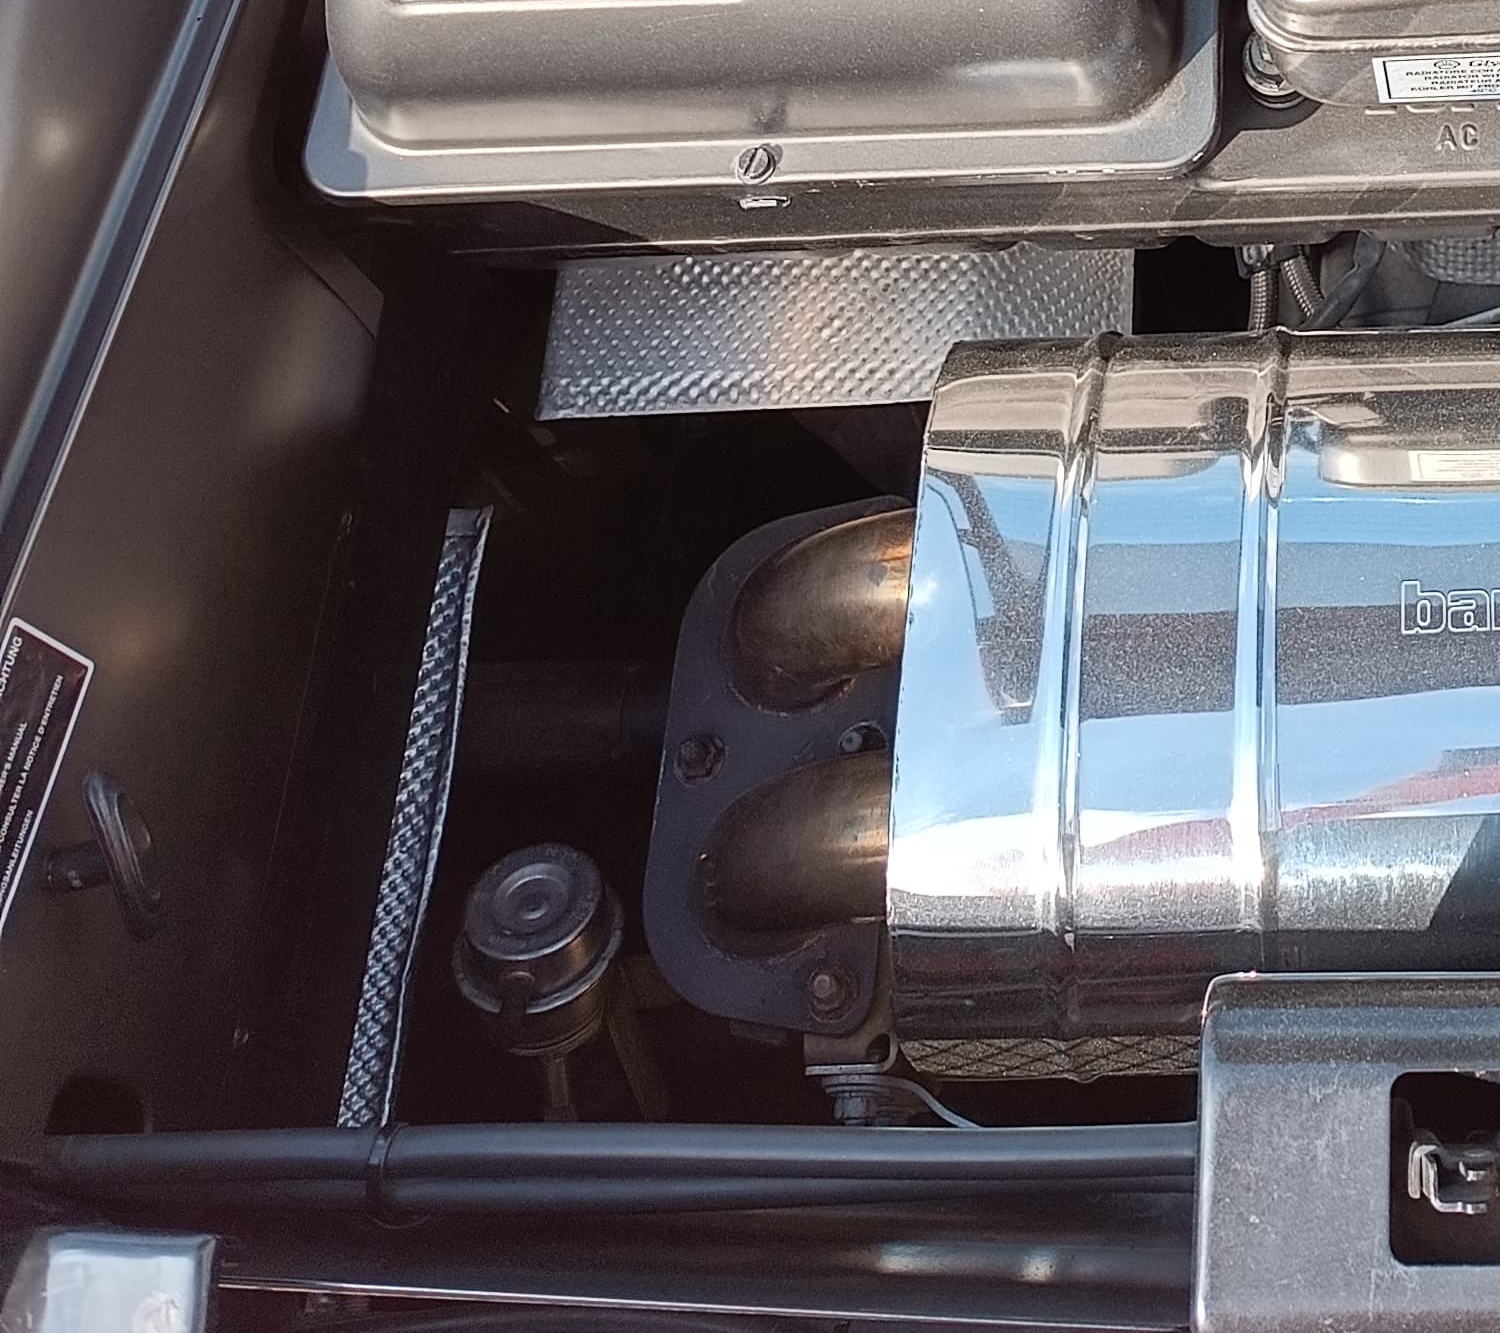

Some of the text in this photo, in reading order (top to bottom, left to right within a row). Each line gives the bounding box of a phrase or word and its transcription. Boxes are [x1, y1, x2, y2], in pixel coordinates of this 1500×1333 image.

[1435, 123, 1479, 151] AC
[0, 636, 22, 699] CHTUNG
[7, 721, 28, 762] MANUAL
[18, 771, 28, 786] LA
[23, 735, 42, 771] NOTICE
